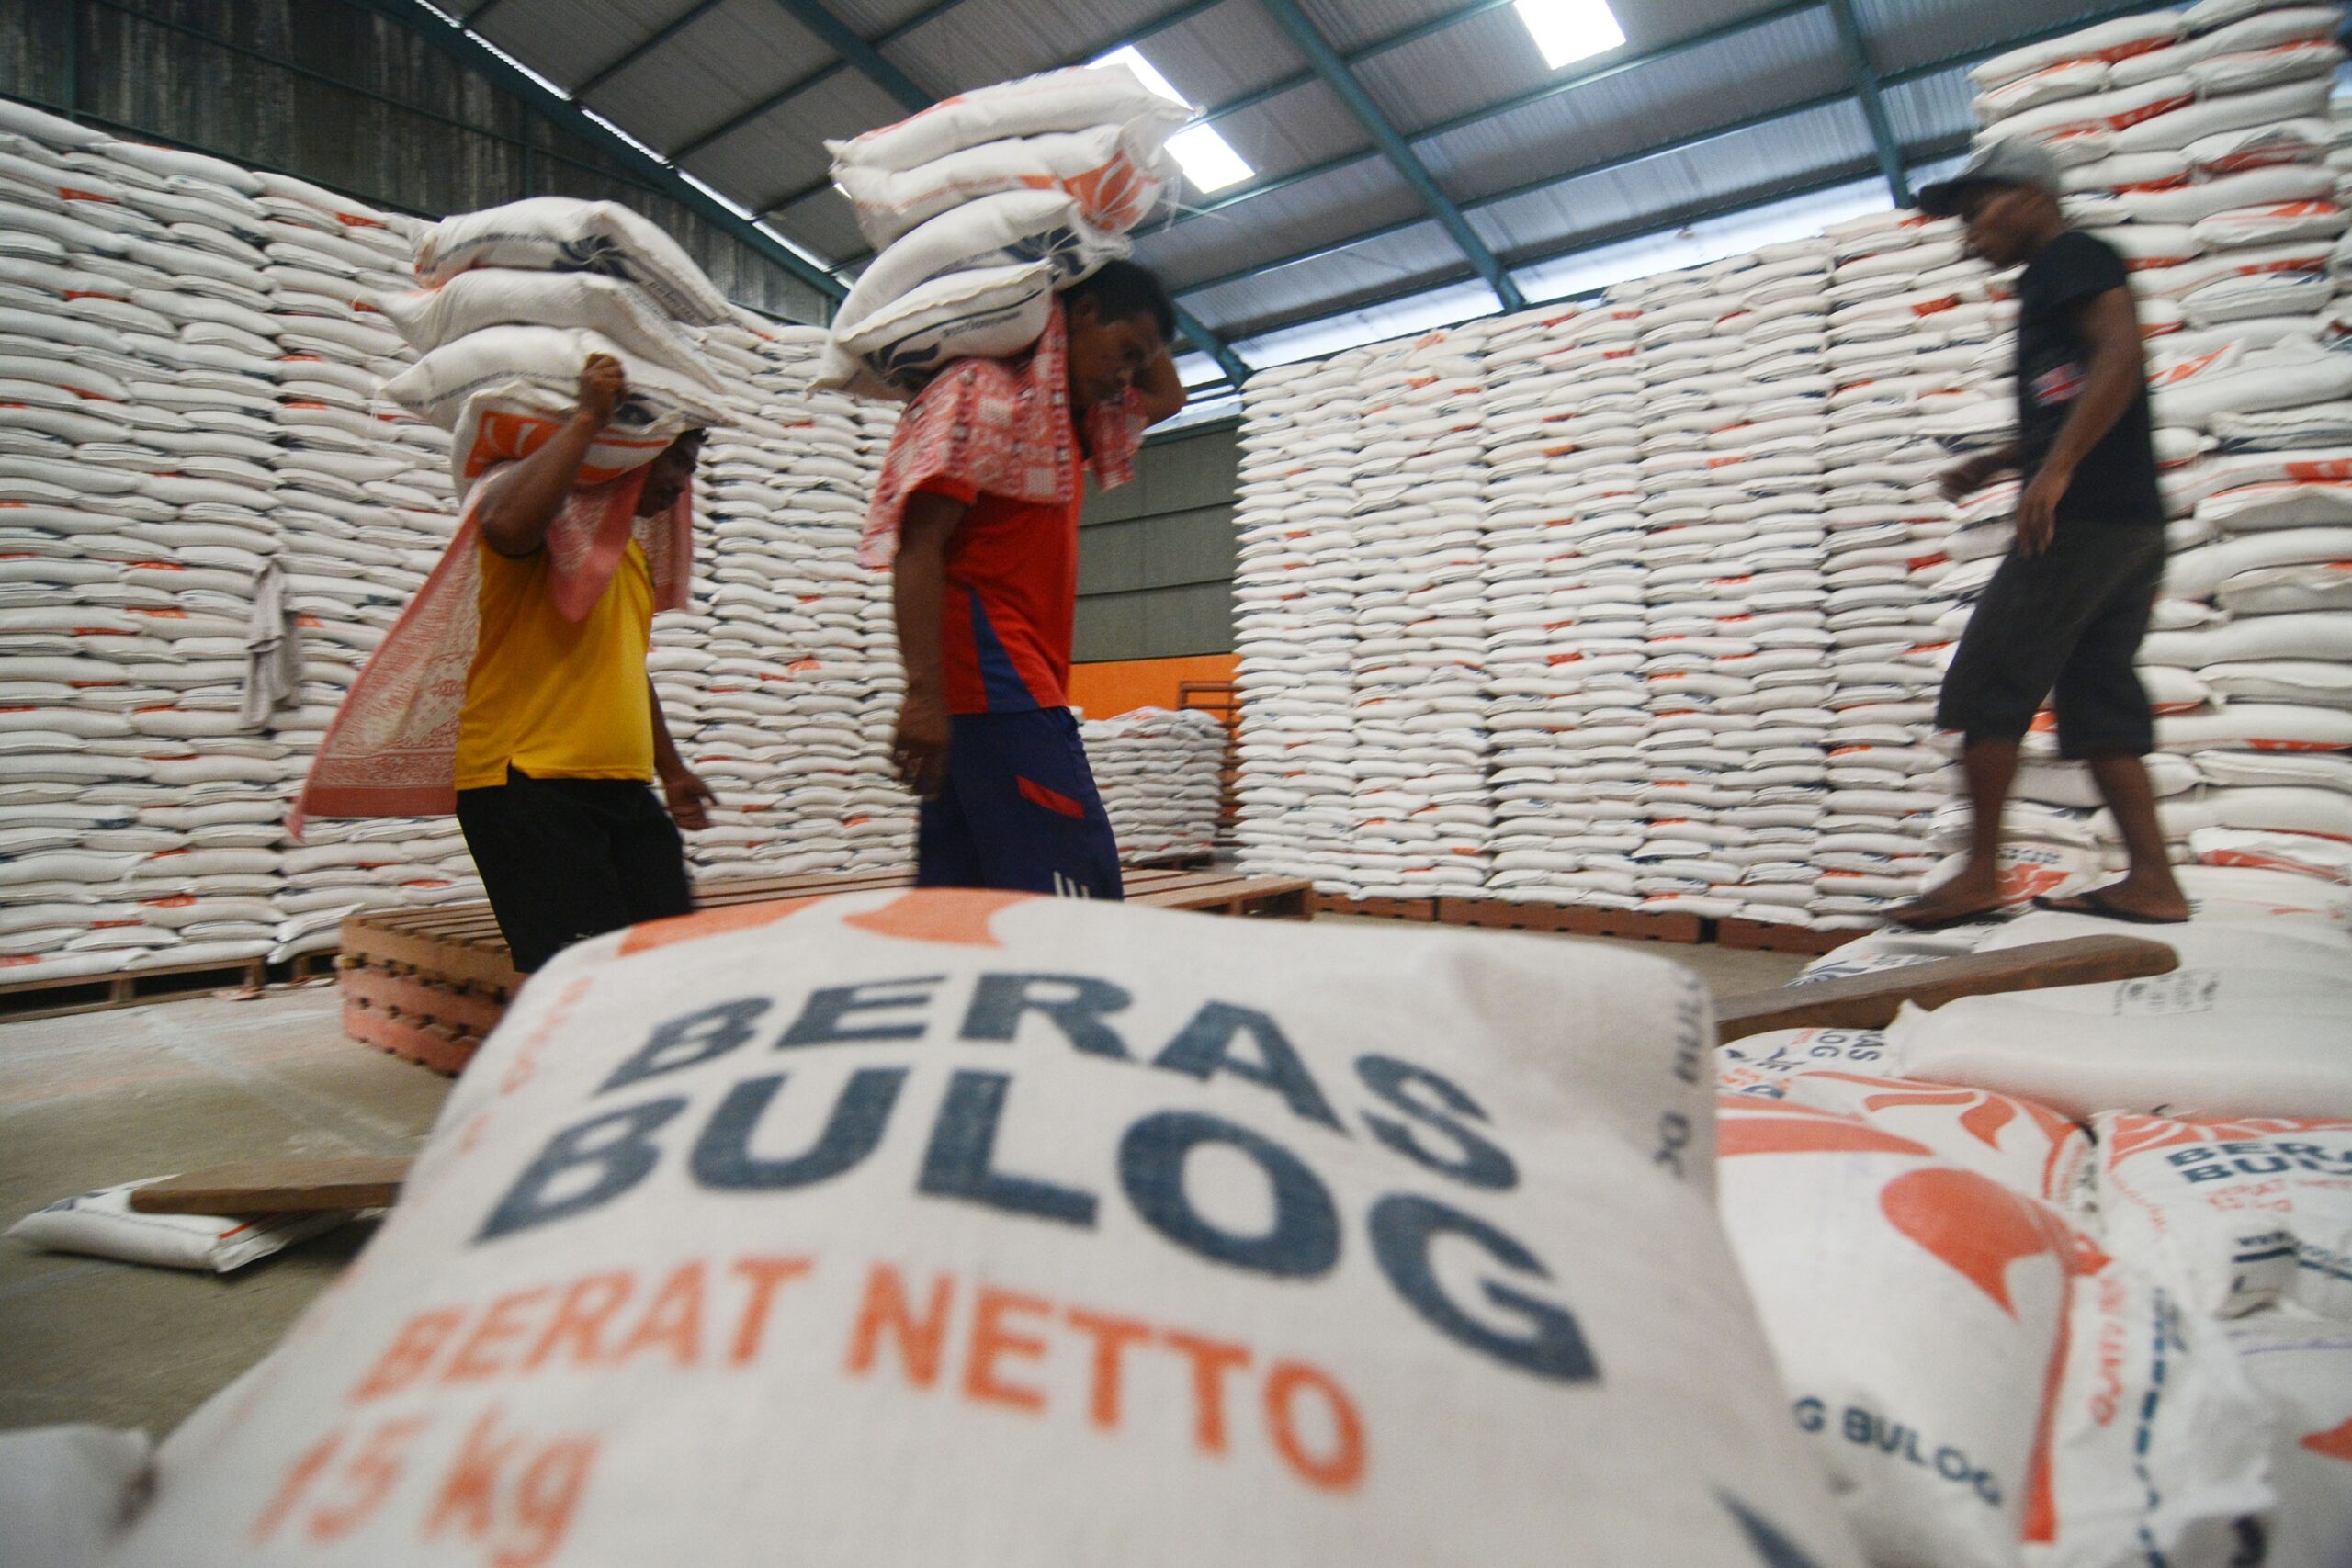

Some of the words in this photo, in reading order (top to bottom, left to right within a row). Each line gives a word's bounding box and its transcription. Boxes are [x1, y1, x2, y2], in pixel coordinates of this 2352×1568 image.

[589, 972, 1520, 1191] BERAS
[1809, 1029, 1848, 1059] OG
[1848, 1029, 1887, 1062] AS
[2165, 1142, 2352, 1168] BER
[469, 1066, 1604, 1388] BULOG
[344, 1253, 814, 1405] BERAT
[840, 1258, 1372, 1495] NETTO
[243, 1407, 434, 1551] 15
[416, 1403, 605, 1568] kg
[1841, 1405, 2003, 1507] BULOG
